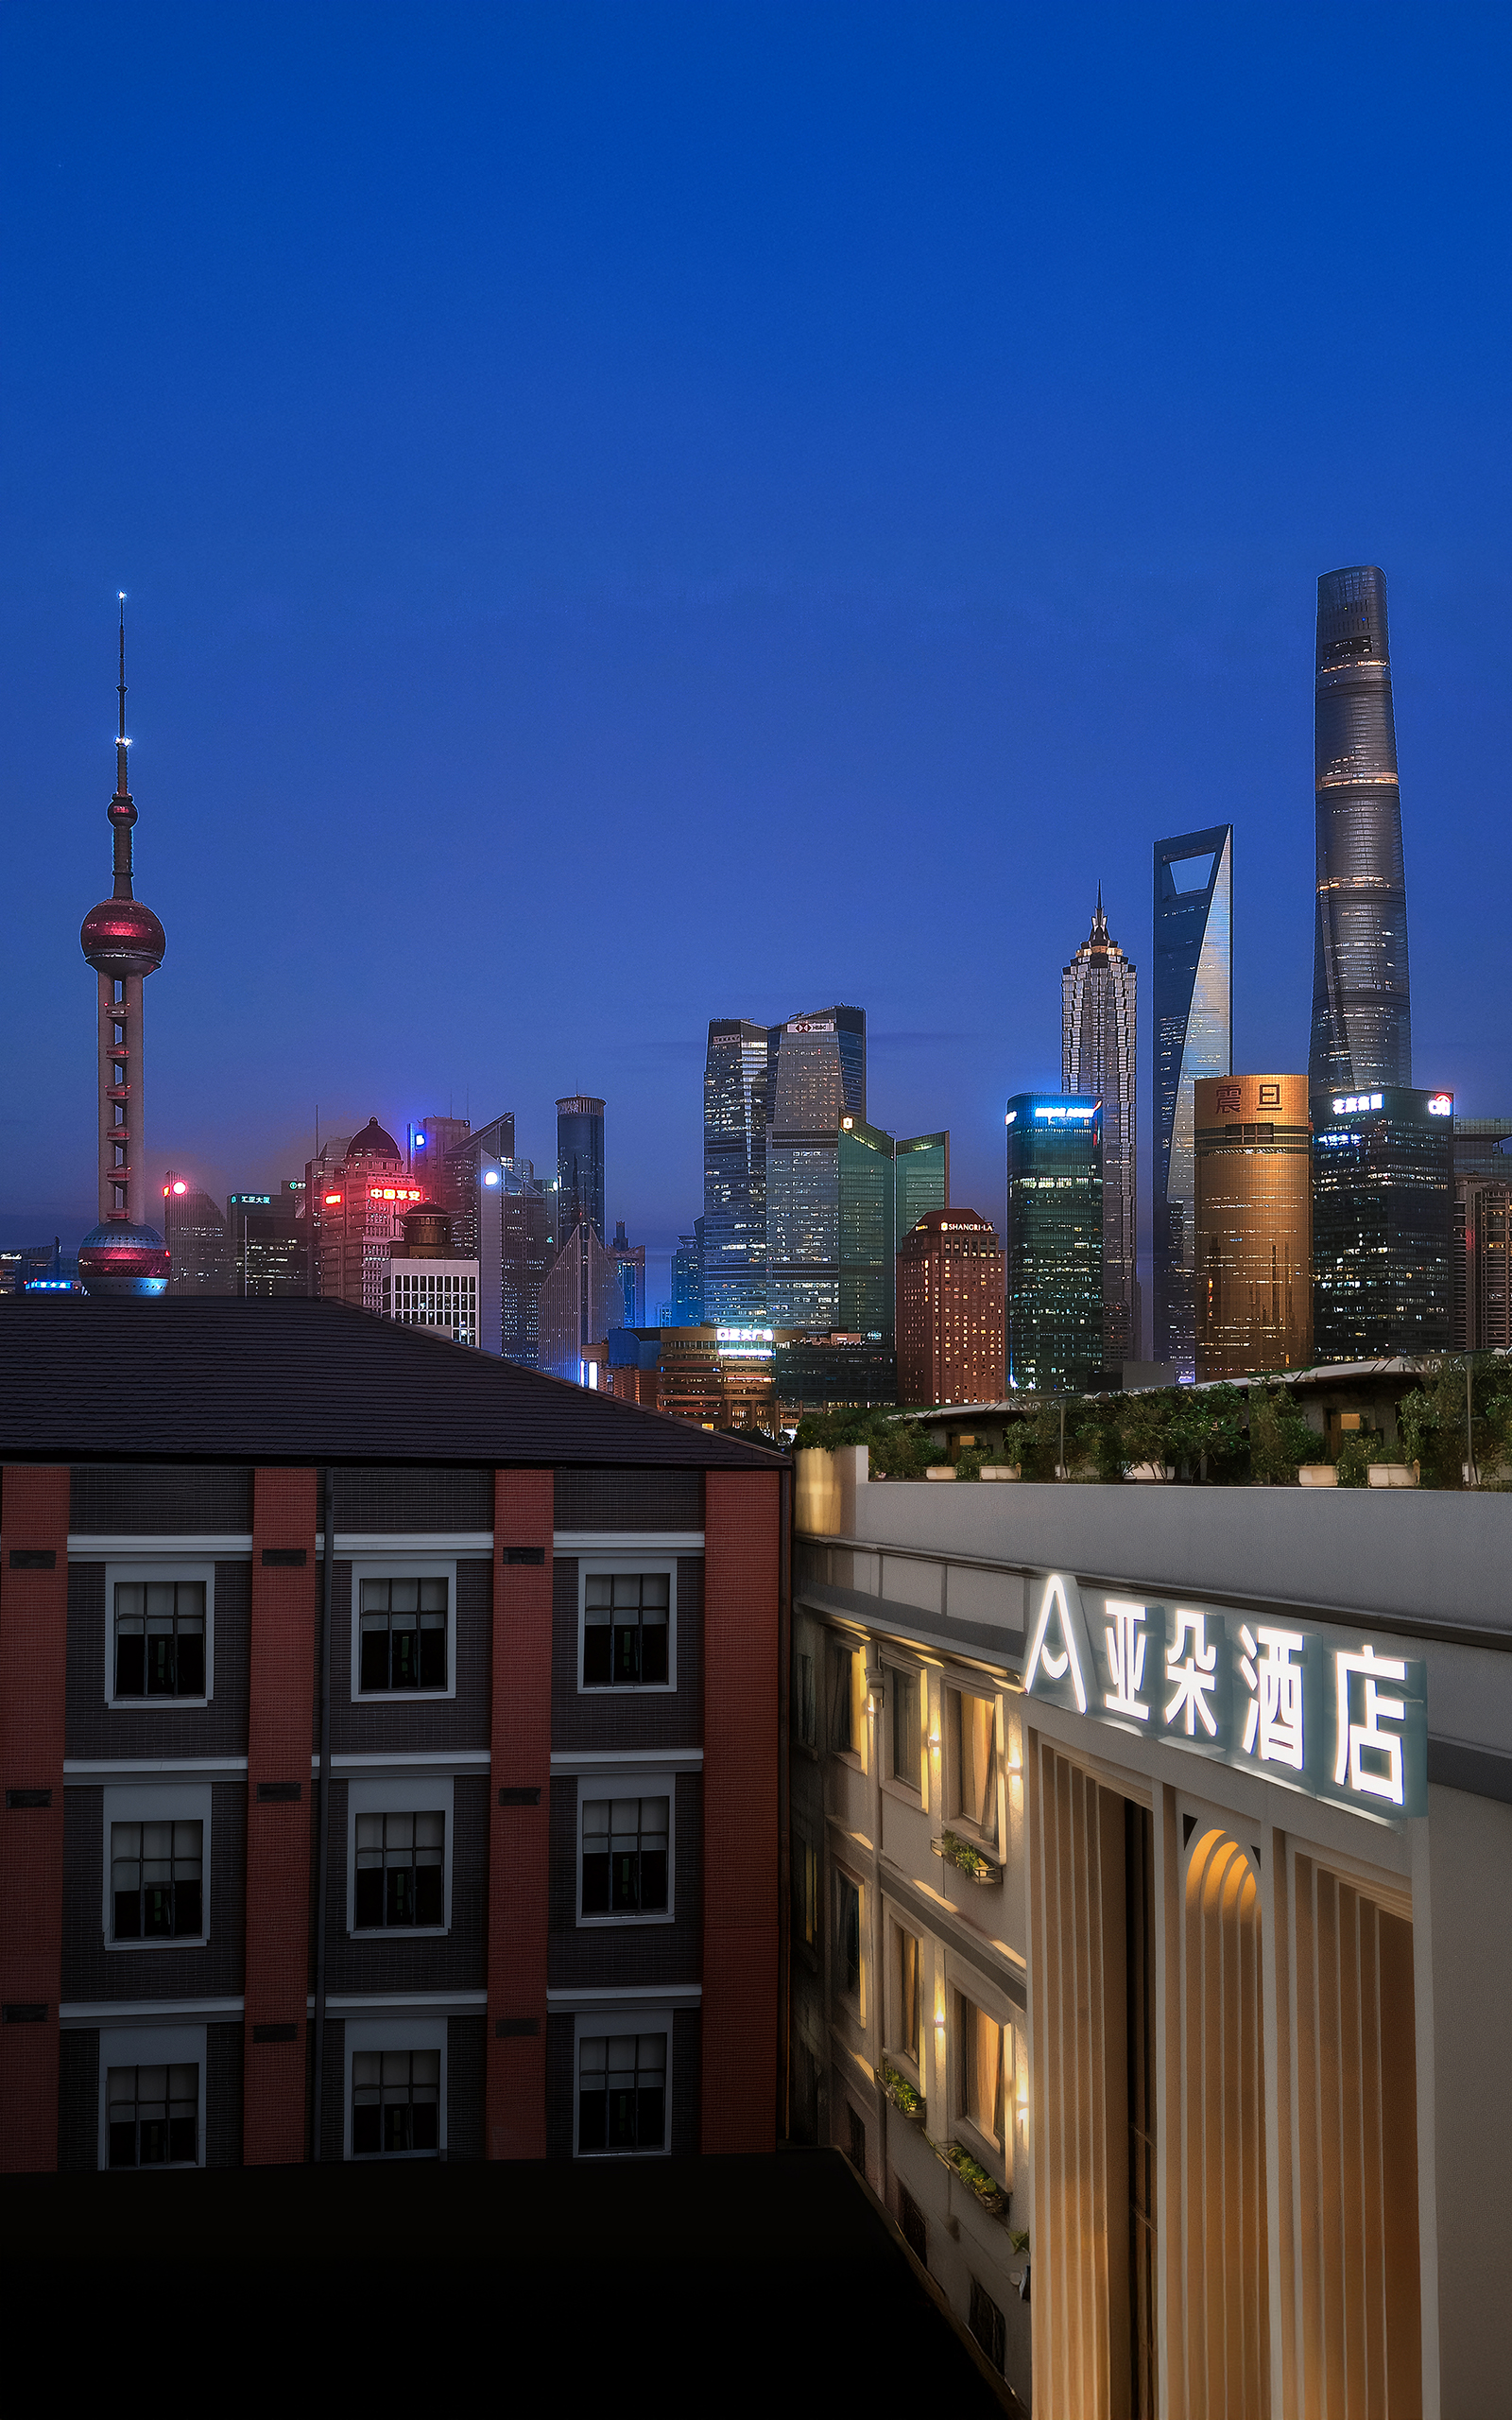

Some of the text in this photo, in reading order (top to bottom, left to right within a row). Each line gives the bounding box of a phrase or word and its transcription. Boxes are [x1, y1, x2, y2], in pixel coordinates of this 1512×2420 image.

[1215, 1084, 1282, 1114] 震旦
[1104, 1599, 1408, 1806] 亚朵酒店
